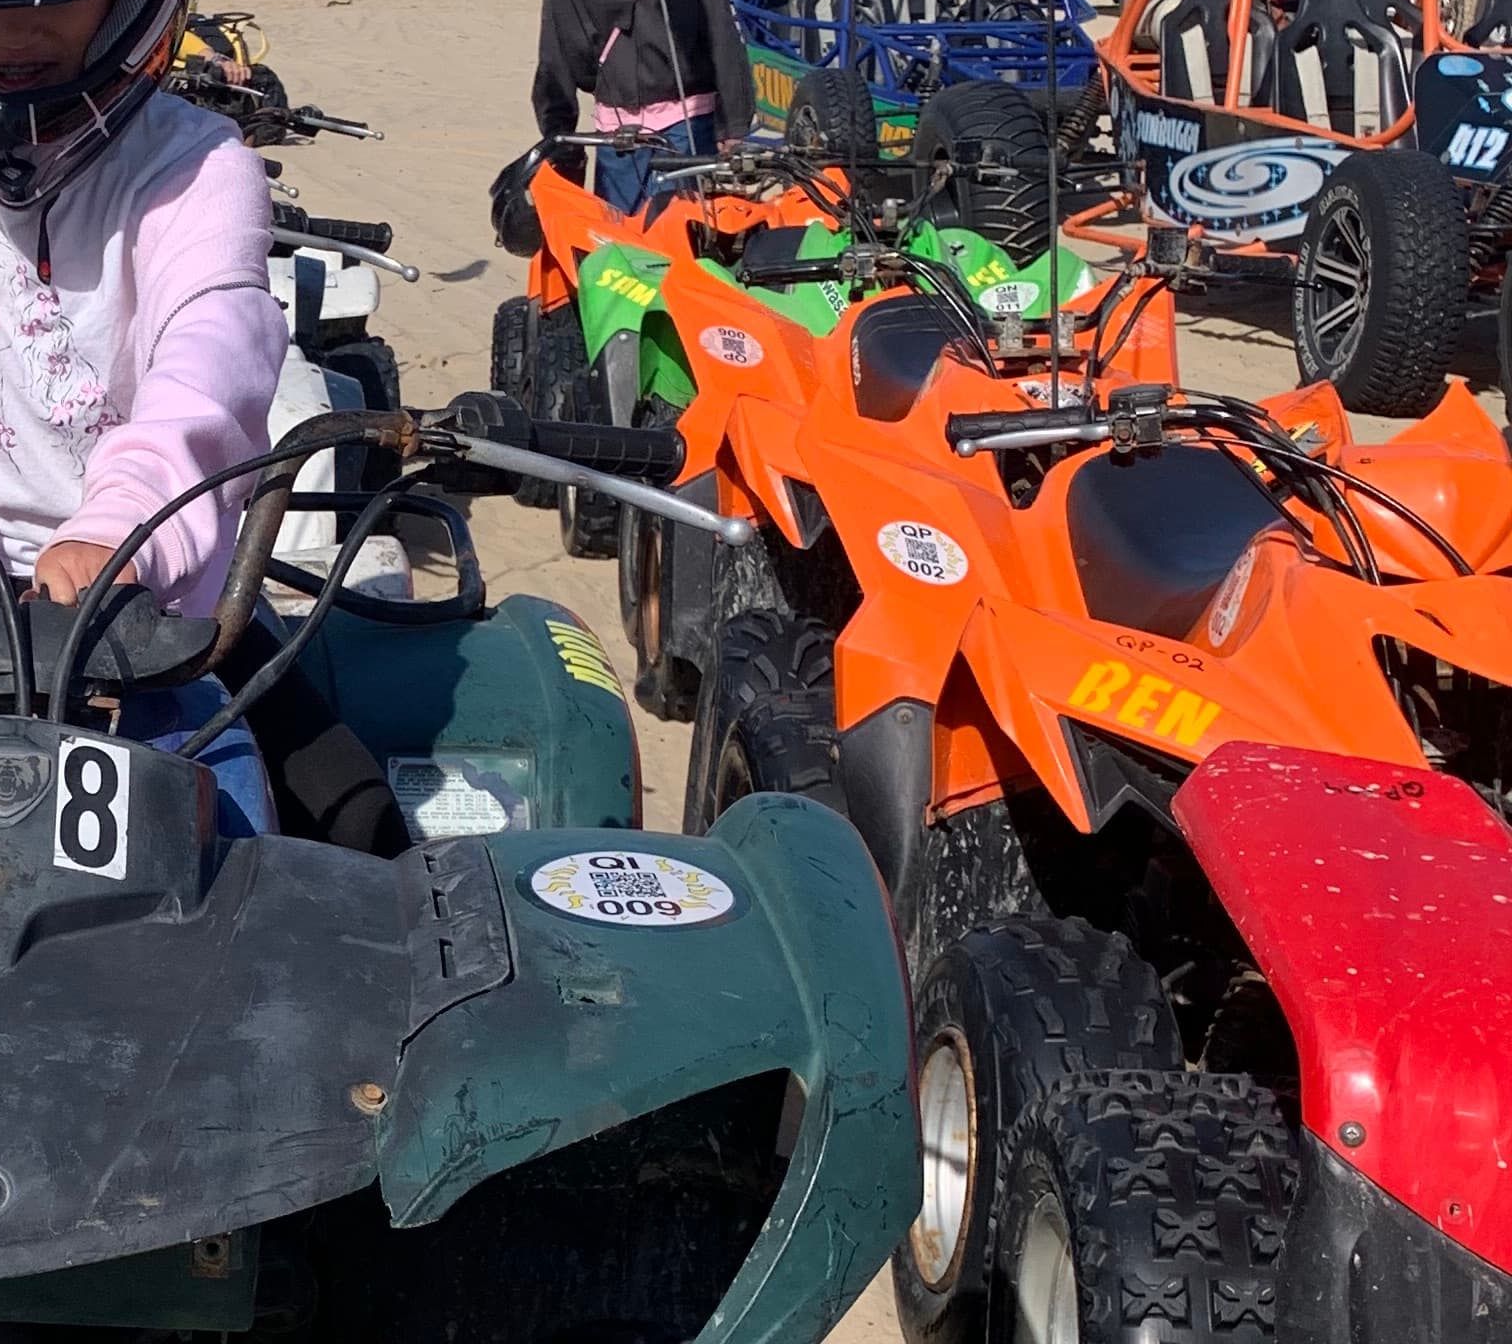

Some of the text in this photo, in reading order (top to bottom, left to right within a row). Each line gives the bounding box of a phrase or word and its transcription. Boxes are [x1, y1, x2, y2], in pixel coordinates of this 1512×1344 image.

[1448, 123, 1510, 171] 412
[595, 269, 657, 306] SAM
[901, 525, 932, 538] QP
[908, 560, 945, 579] 002
[1068, 660, 1222, 746] BEN
[60, 745, 118, 868] 8
[589, 856, 640, 870] QI
[597, 900, 682, 916] 009
